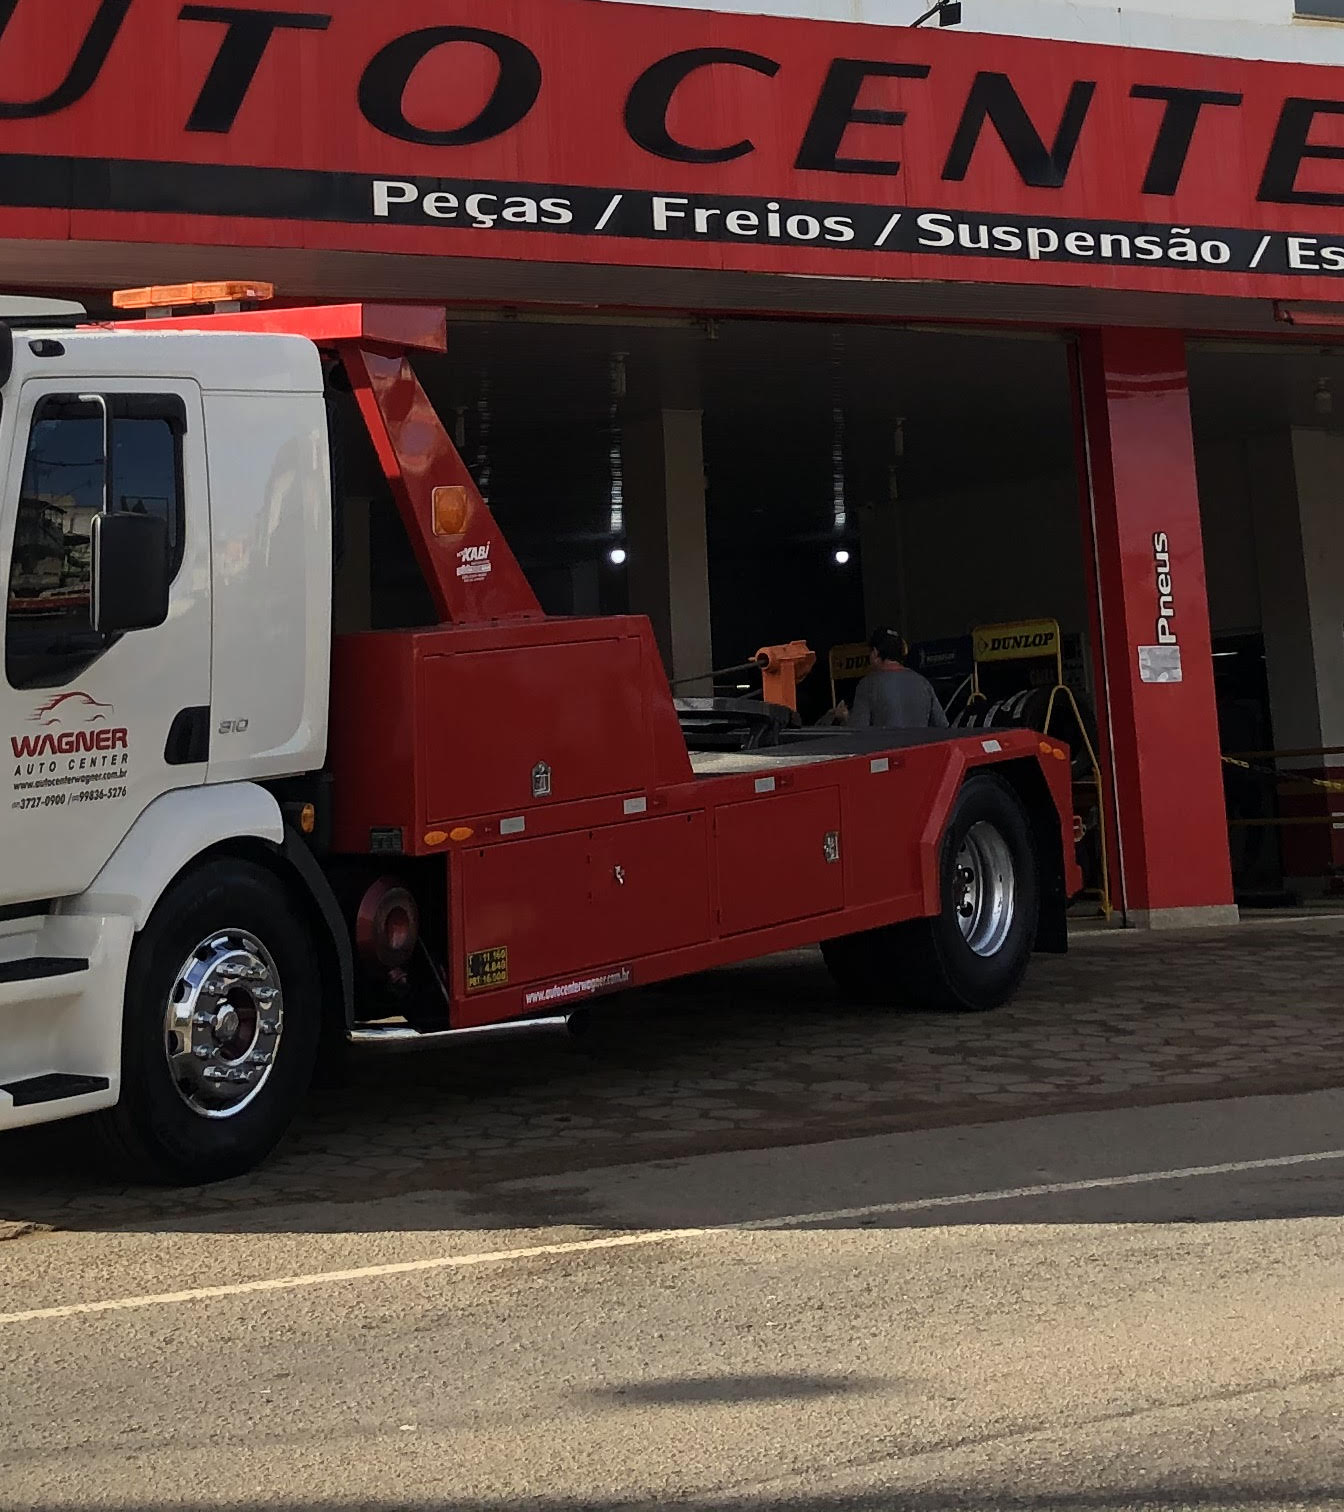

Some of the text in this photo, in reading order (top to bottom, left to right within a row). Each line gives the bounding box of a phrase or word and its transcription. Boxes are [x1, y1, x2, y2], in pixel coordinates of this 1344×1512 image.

[372, 180, 574, 229] Peças
[653, 197, 856, 243] Freios
[916, 213, 1232, 267] Suspensão
[1154, 531, 1177, 644] Pneus
[990, 632, 1055, 652] DUNLOP
[10, 728, 128, 758] WAGNER
[14, 753, 128, 776] AUTO CENTER
